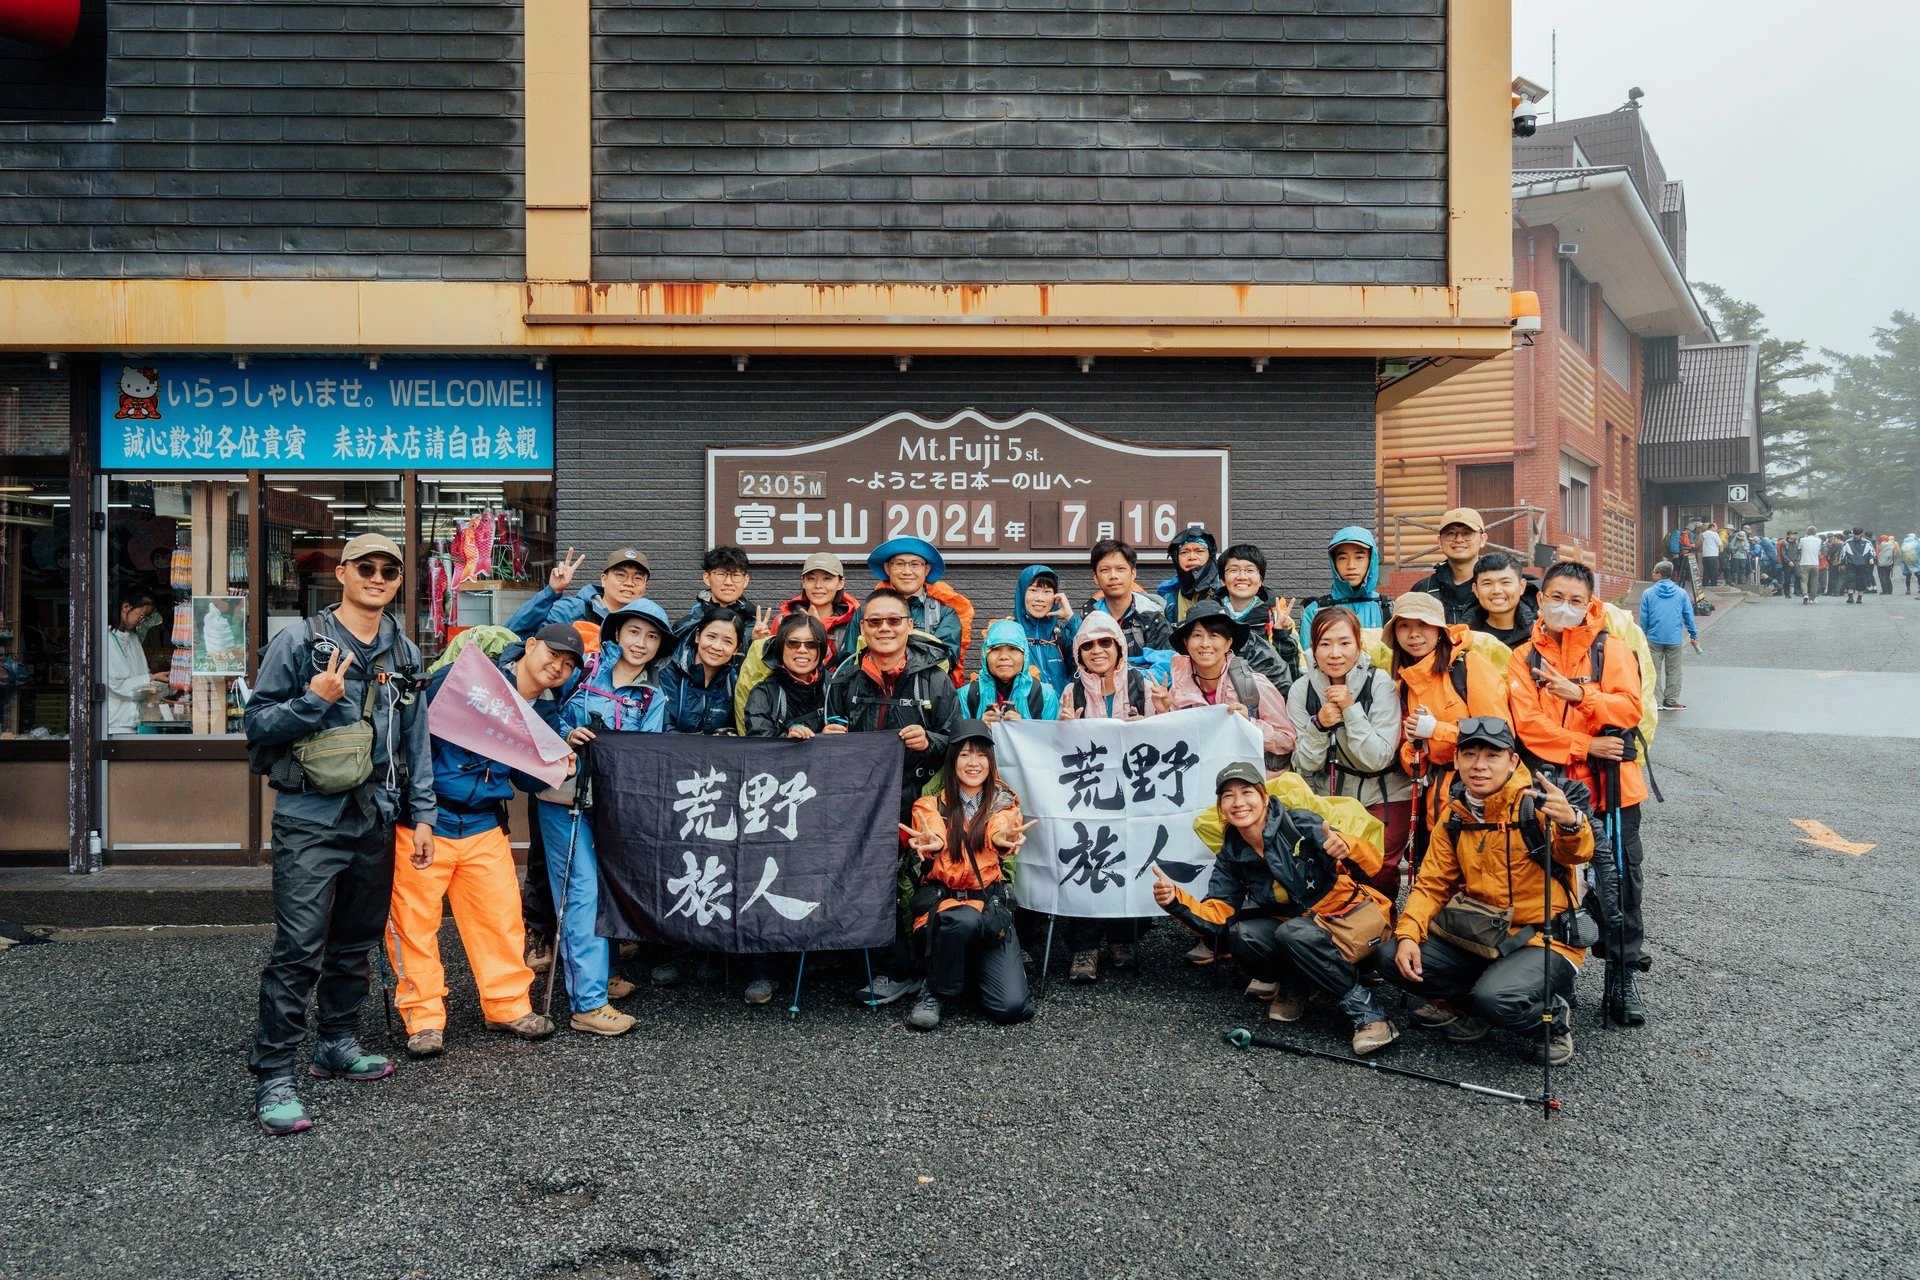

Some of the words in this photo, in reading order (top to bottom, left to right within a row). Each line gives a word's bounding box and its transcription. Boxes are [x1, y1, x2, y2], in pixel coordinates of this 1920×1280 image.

[167, 377, 374, 408] いらっしゃいませ。
[389, 379, 542, 407] WELCOME!!
[898, 434, 1000, 469] Mt.Fuji
[734, 502, 868, 545] 富士山
[673, 765, 817, 841] 荒野
[1058, 740, 1200, 812] 荒野
[664, 851, 821, 926] 旅人
[1058, 821, 1208, 894] 旅人
